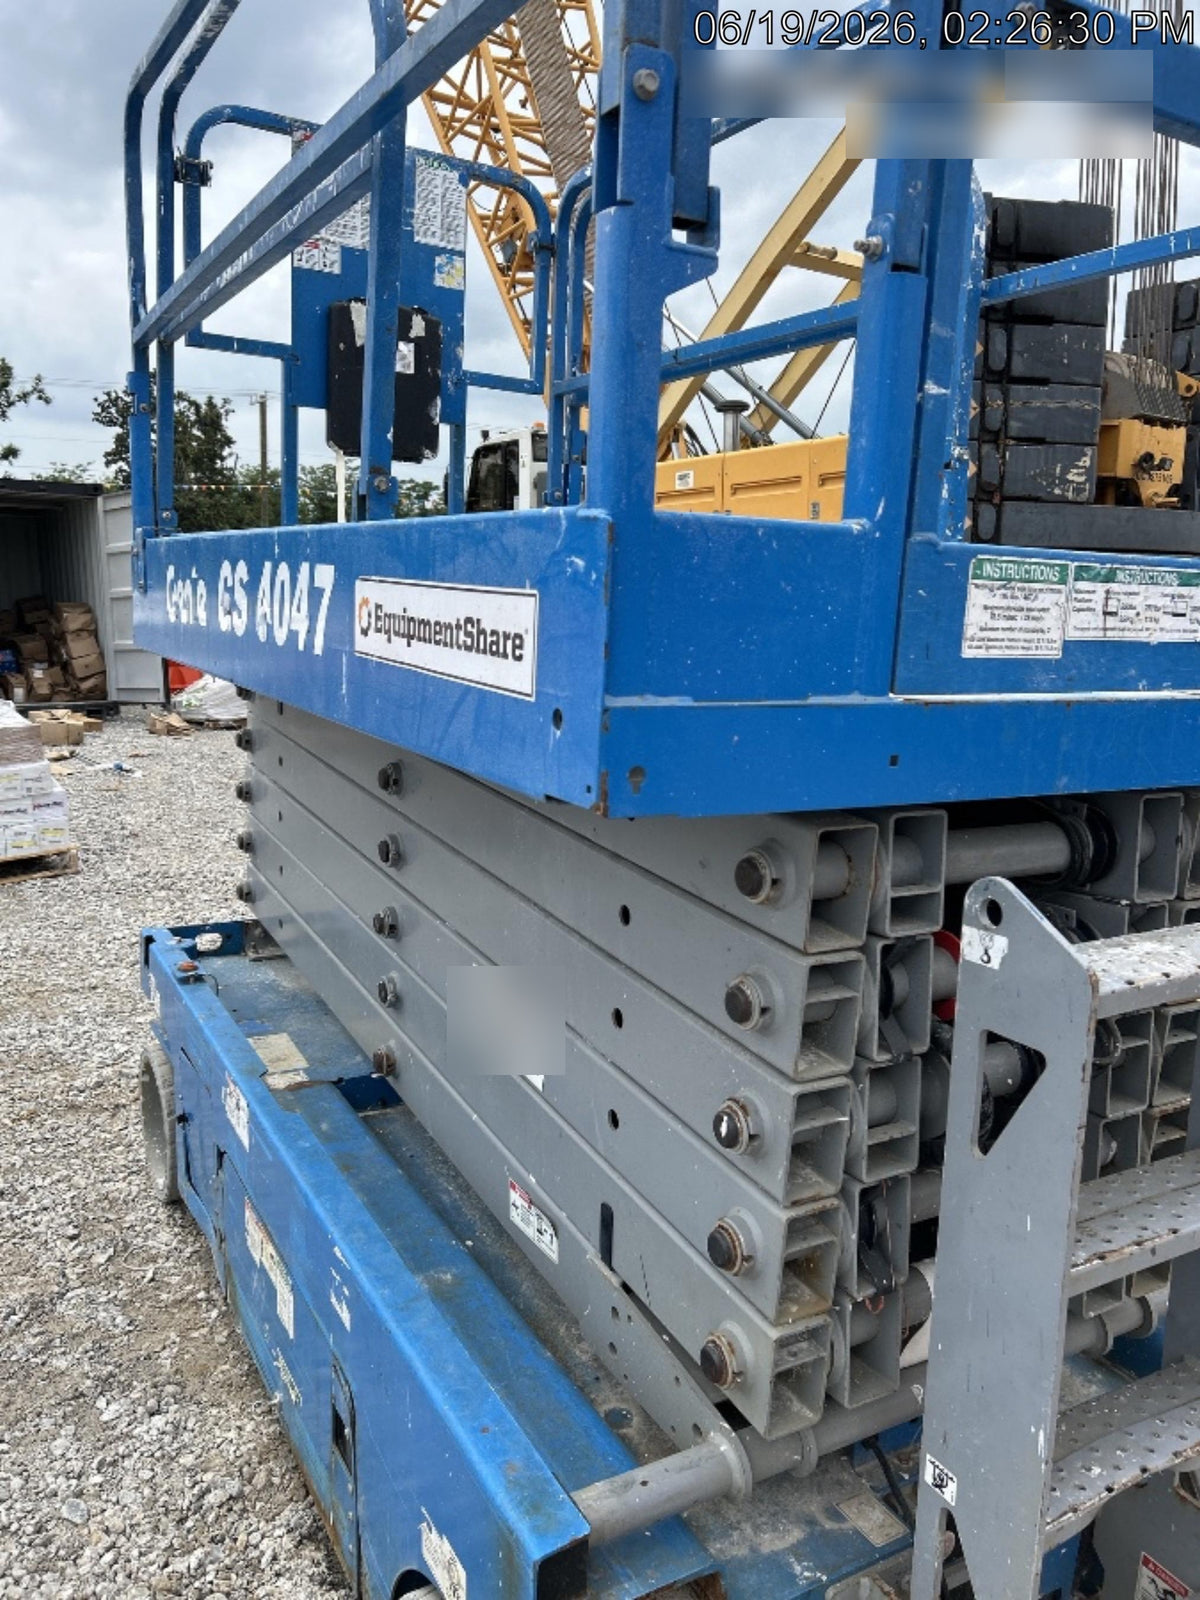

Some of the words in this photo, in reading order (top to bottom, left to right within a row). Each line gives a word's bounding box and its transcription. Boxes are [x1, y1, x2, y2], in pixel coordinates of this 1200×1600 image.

[982, 561, 1061, 581] INSTRUCTIONS
[1114, 569, 1179, 587] INSTRUCTIONS
[374, 602, 524, 662] EquipmentShare
